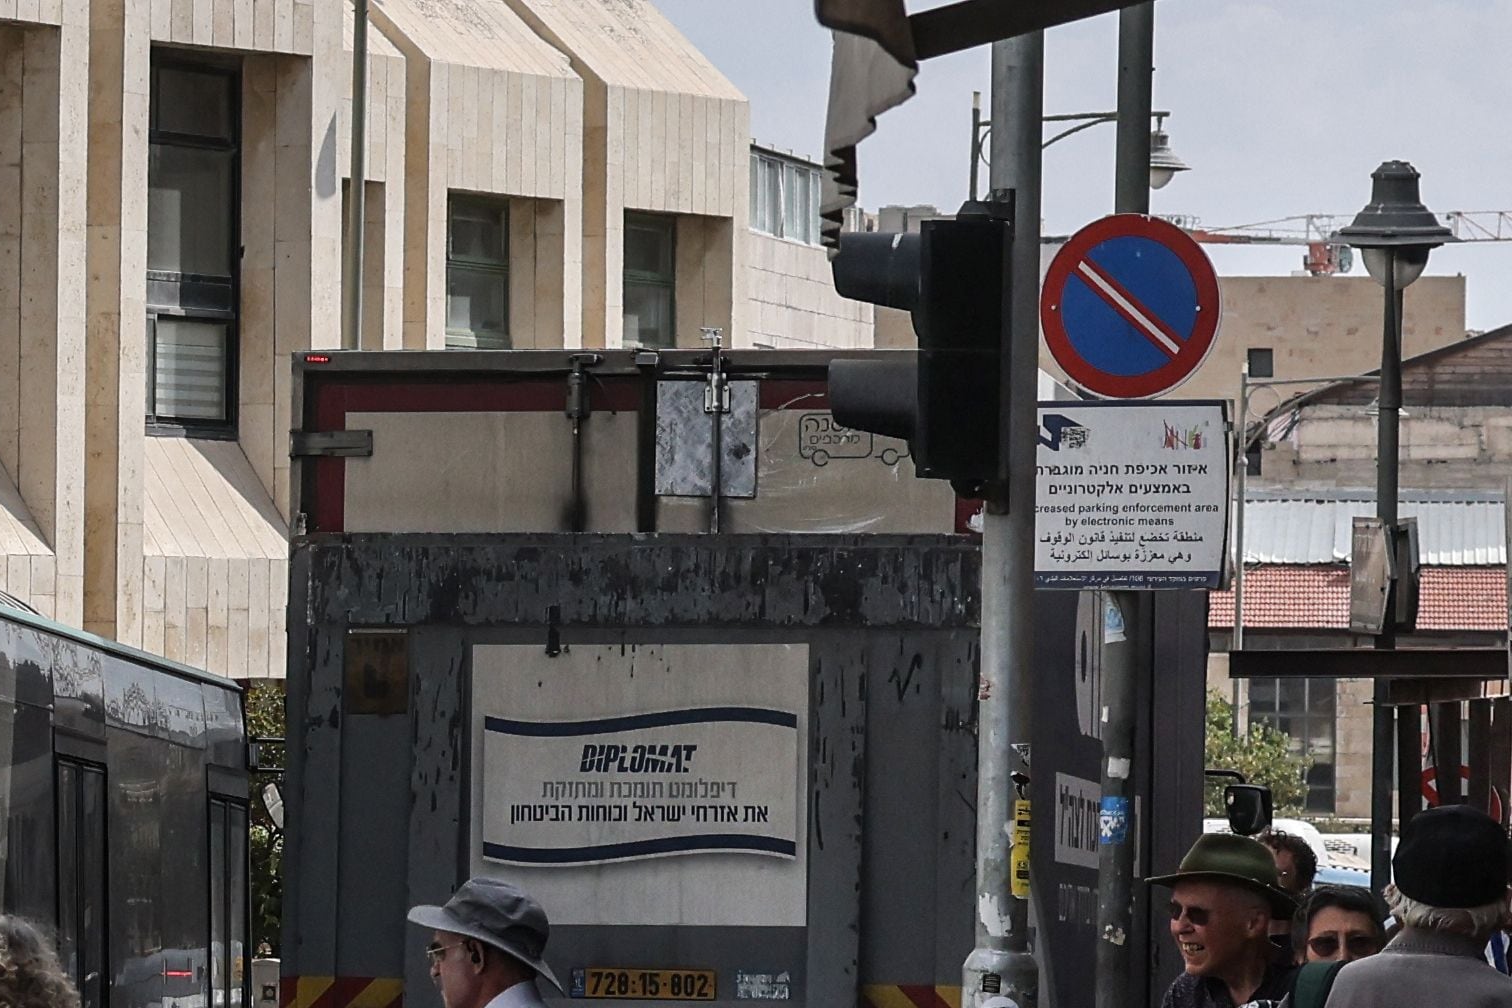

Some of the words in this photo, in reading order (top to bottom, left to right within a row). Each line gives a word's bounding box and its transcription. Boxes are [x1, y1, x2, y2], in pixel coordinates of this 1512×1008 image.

[1089, 464, 1119, 475] חניה
[1124, 464, 1168, 475] אכיפת
[1048, 481, 1124, 497] אלקטרוניים
[1129, 483, 1191, 495] באמצעים
[1035, 502, 1076, 513] creased
[1078, 502, 1119, 515] parking
[1122, 502, 1192, 513] enforcement
[1194, 504, 1219, 513] area
[1065, 516, 1078, 528] by
[1080, 516, 1135, 526] electronic
[1137, 518, 1175, 526] means
[1039, 531, 1076, 546] الوقوف
[1078, 531, 1106, 545] قانون
[1109, 531, 1135, 546] لتنفيذ
[1138, 532, 1170, 547] تخضع
[1173, 530, 1204, 542] منطقة
[1096, 549, 1132, 563] بوسائل
[1167, 551, 1192, 564] وهي
[579, 744, 698, 773] DIPLOMAT
[608, 781, 664, 799] תומכת
[668, 778, 738, 799] דיפלומט
[510, 804, 573, 825] הביטחון
[577, 804, 628, 822] וכוחות
[632, 801, 686, 822] ישראל
[691, 804, 738, 822] אזרחי
[742, 805, 769, 823] את
